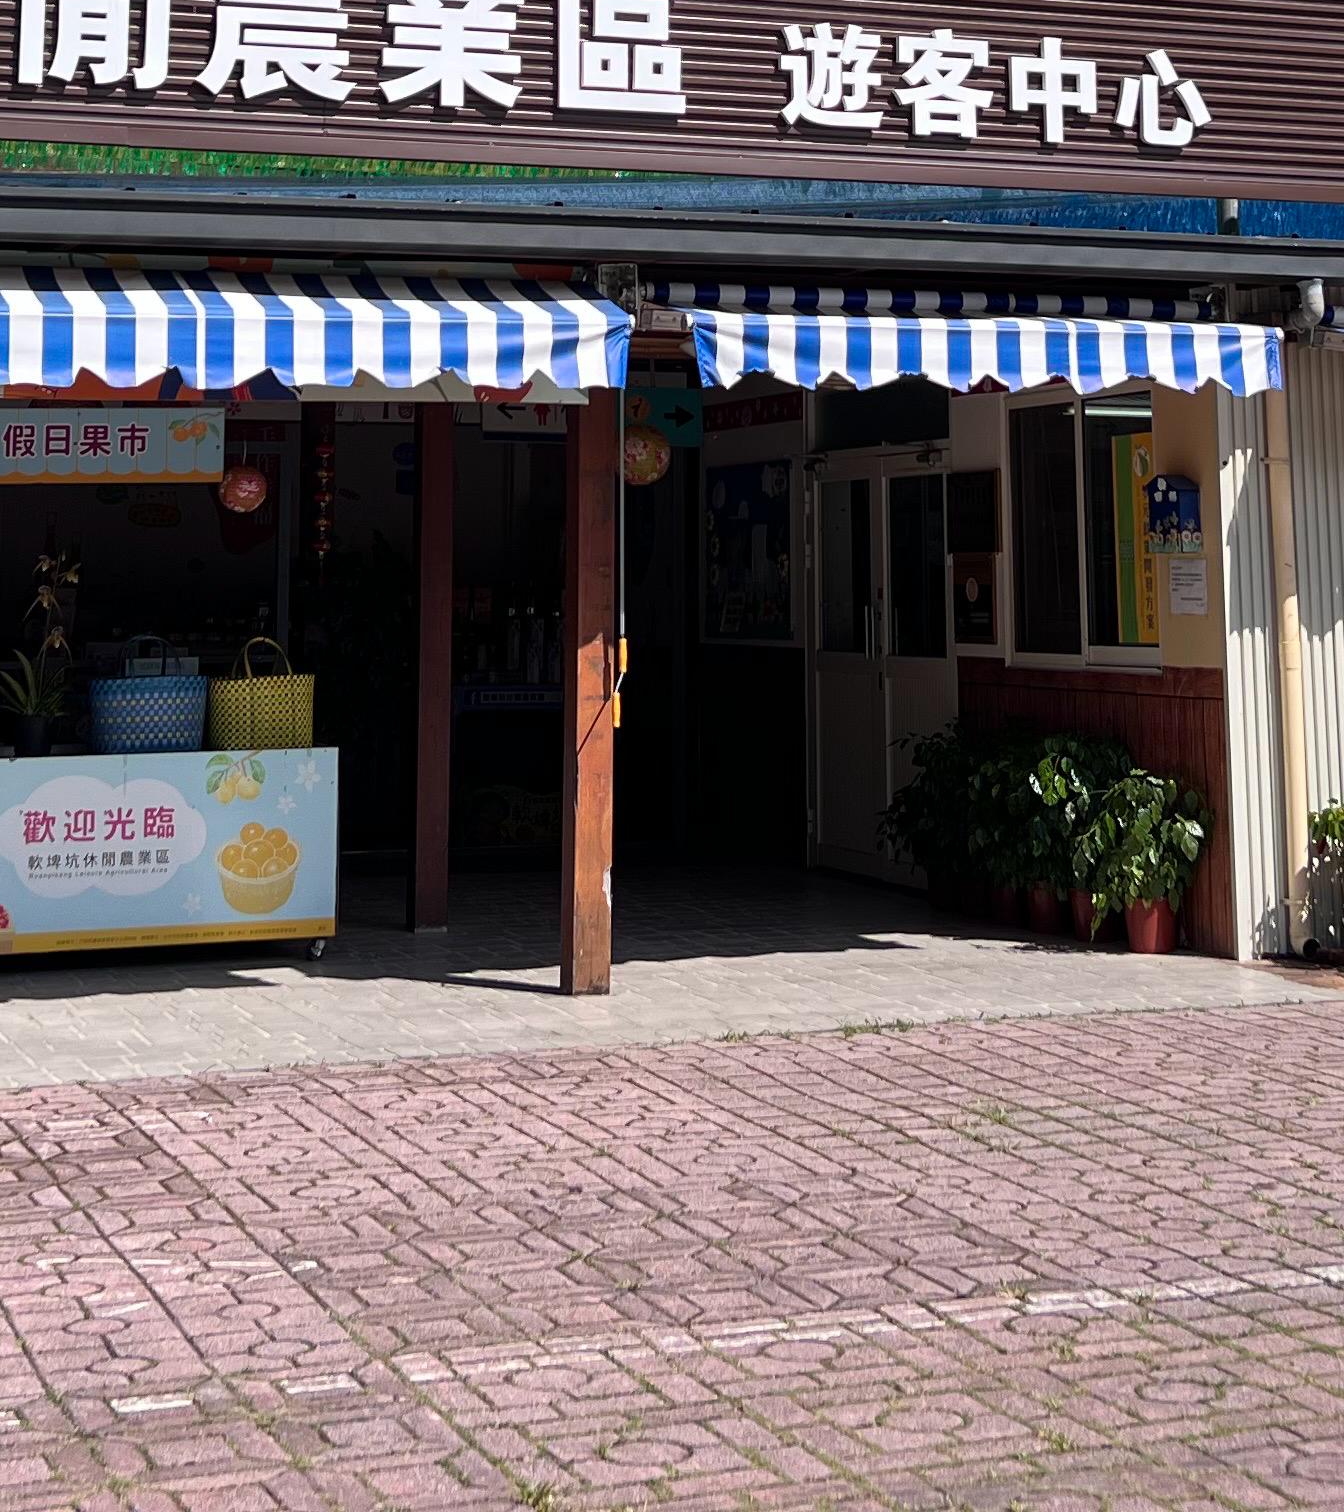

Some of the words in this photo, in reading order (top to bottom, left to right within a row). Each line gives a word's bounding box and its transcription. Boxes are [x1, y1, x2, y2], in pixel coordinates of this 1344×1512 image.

[779, 22, 1213, 148] 遊客中心
[1, 422, 151, 458] 假日果市
[22, 806, 176, 845] 歡迎光臨
[27, 848, 171, 871] 軟埤坑休閒農業區
